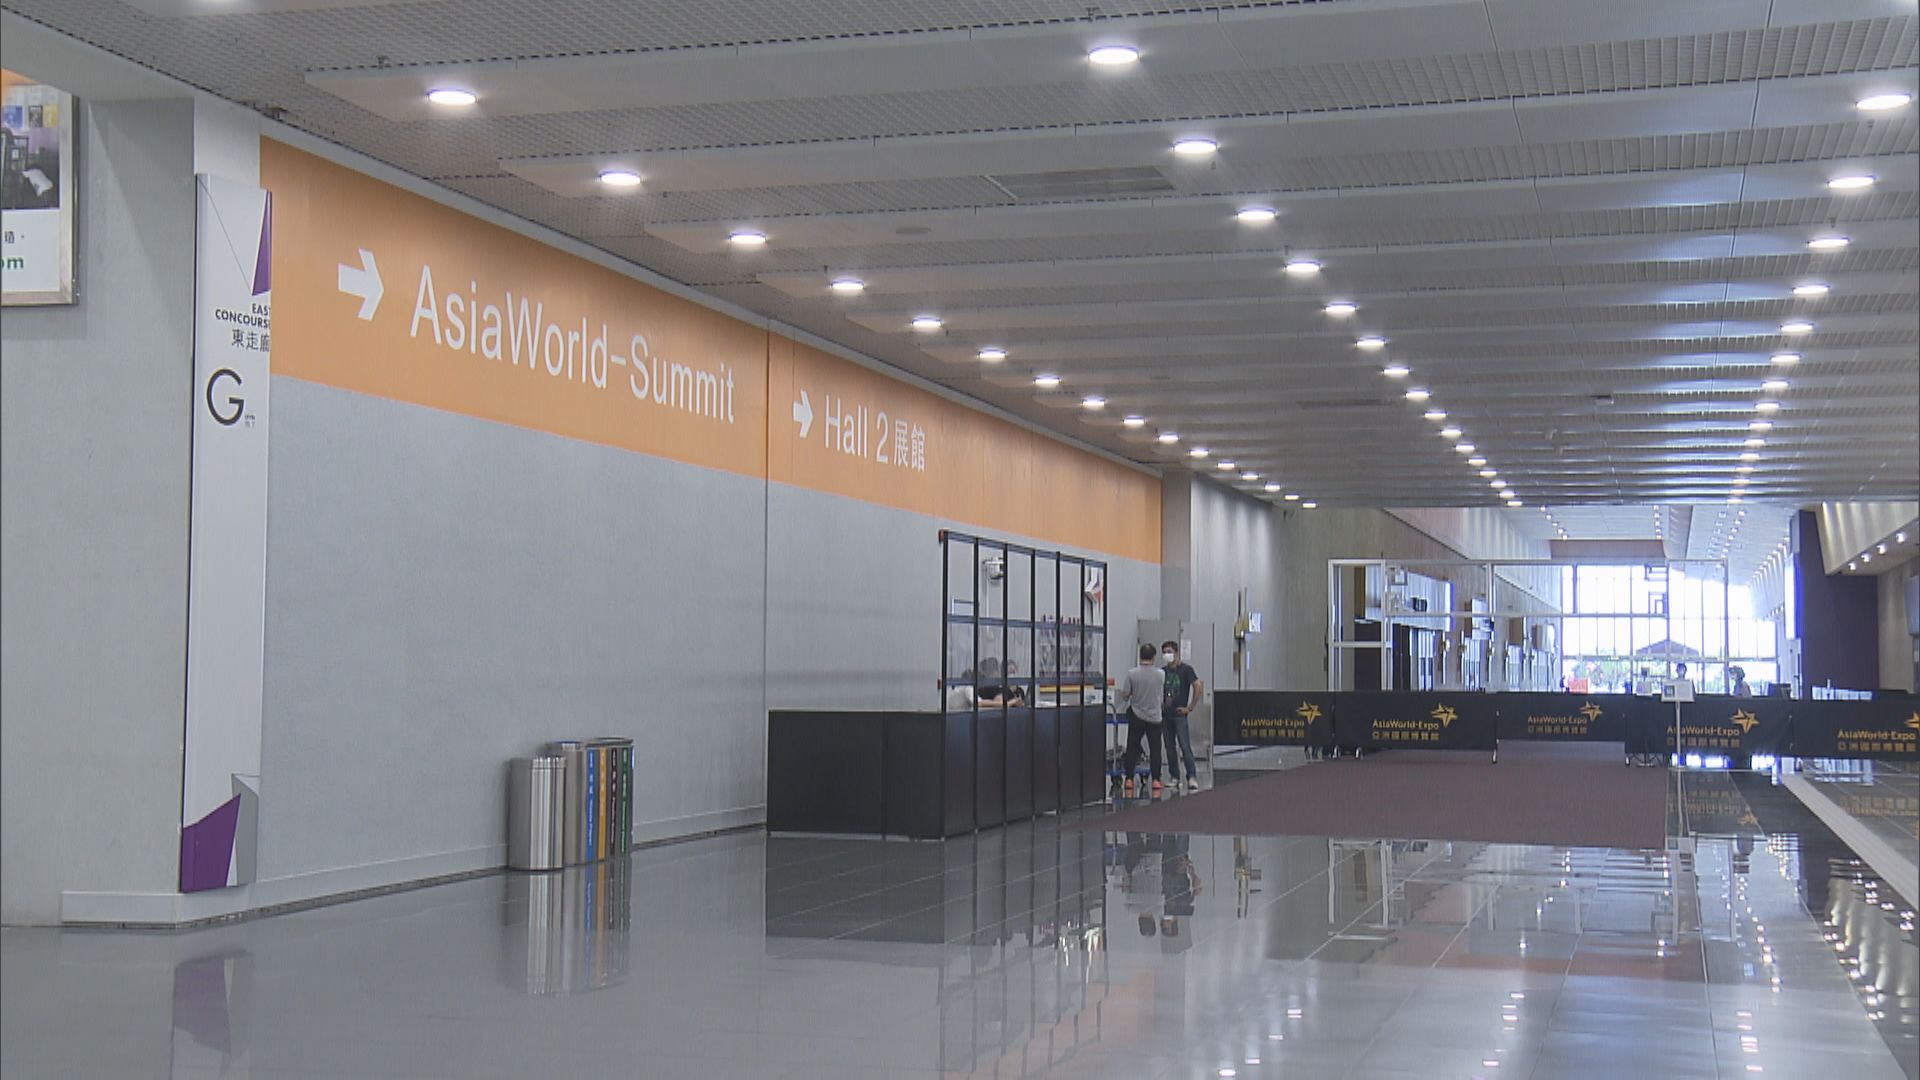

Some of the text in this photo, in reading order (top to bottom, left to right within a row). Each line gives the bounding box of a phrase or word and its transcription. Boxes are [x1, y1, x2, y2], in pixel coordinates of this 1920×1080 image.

[410, 264, 735, 424] AsiaWorld-Summit
[206, 368, 244, 426] G
[825, 394, 926, 472] Hall 2 展館
[1373, 719, 1439, 730] AsiaWorld-Expo
[1838, 731, 1916, 741] AsiaWorld-Expo
